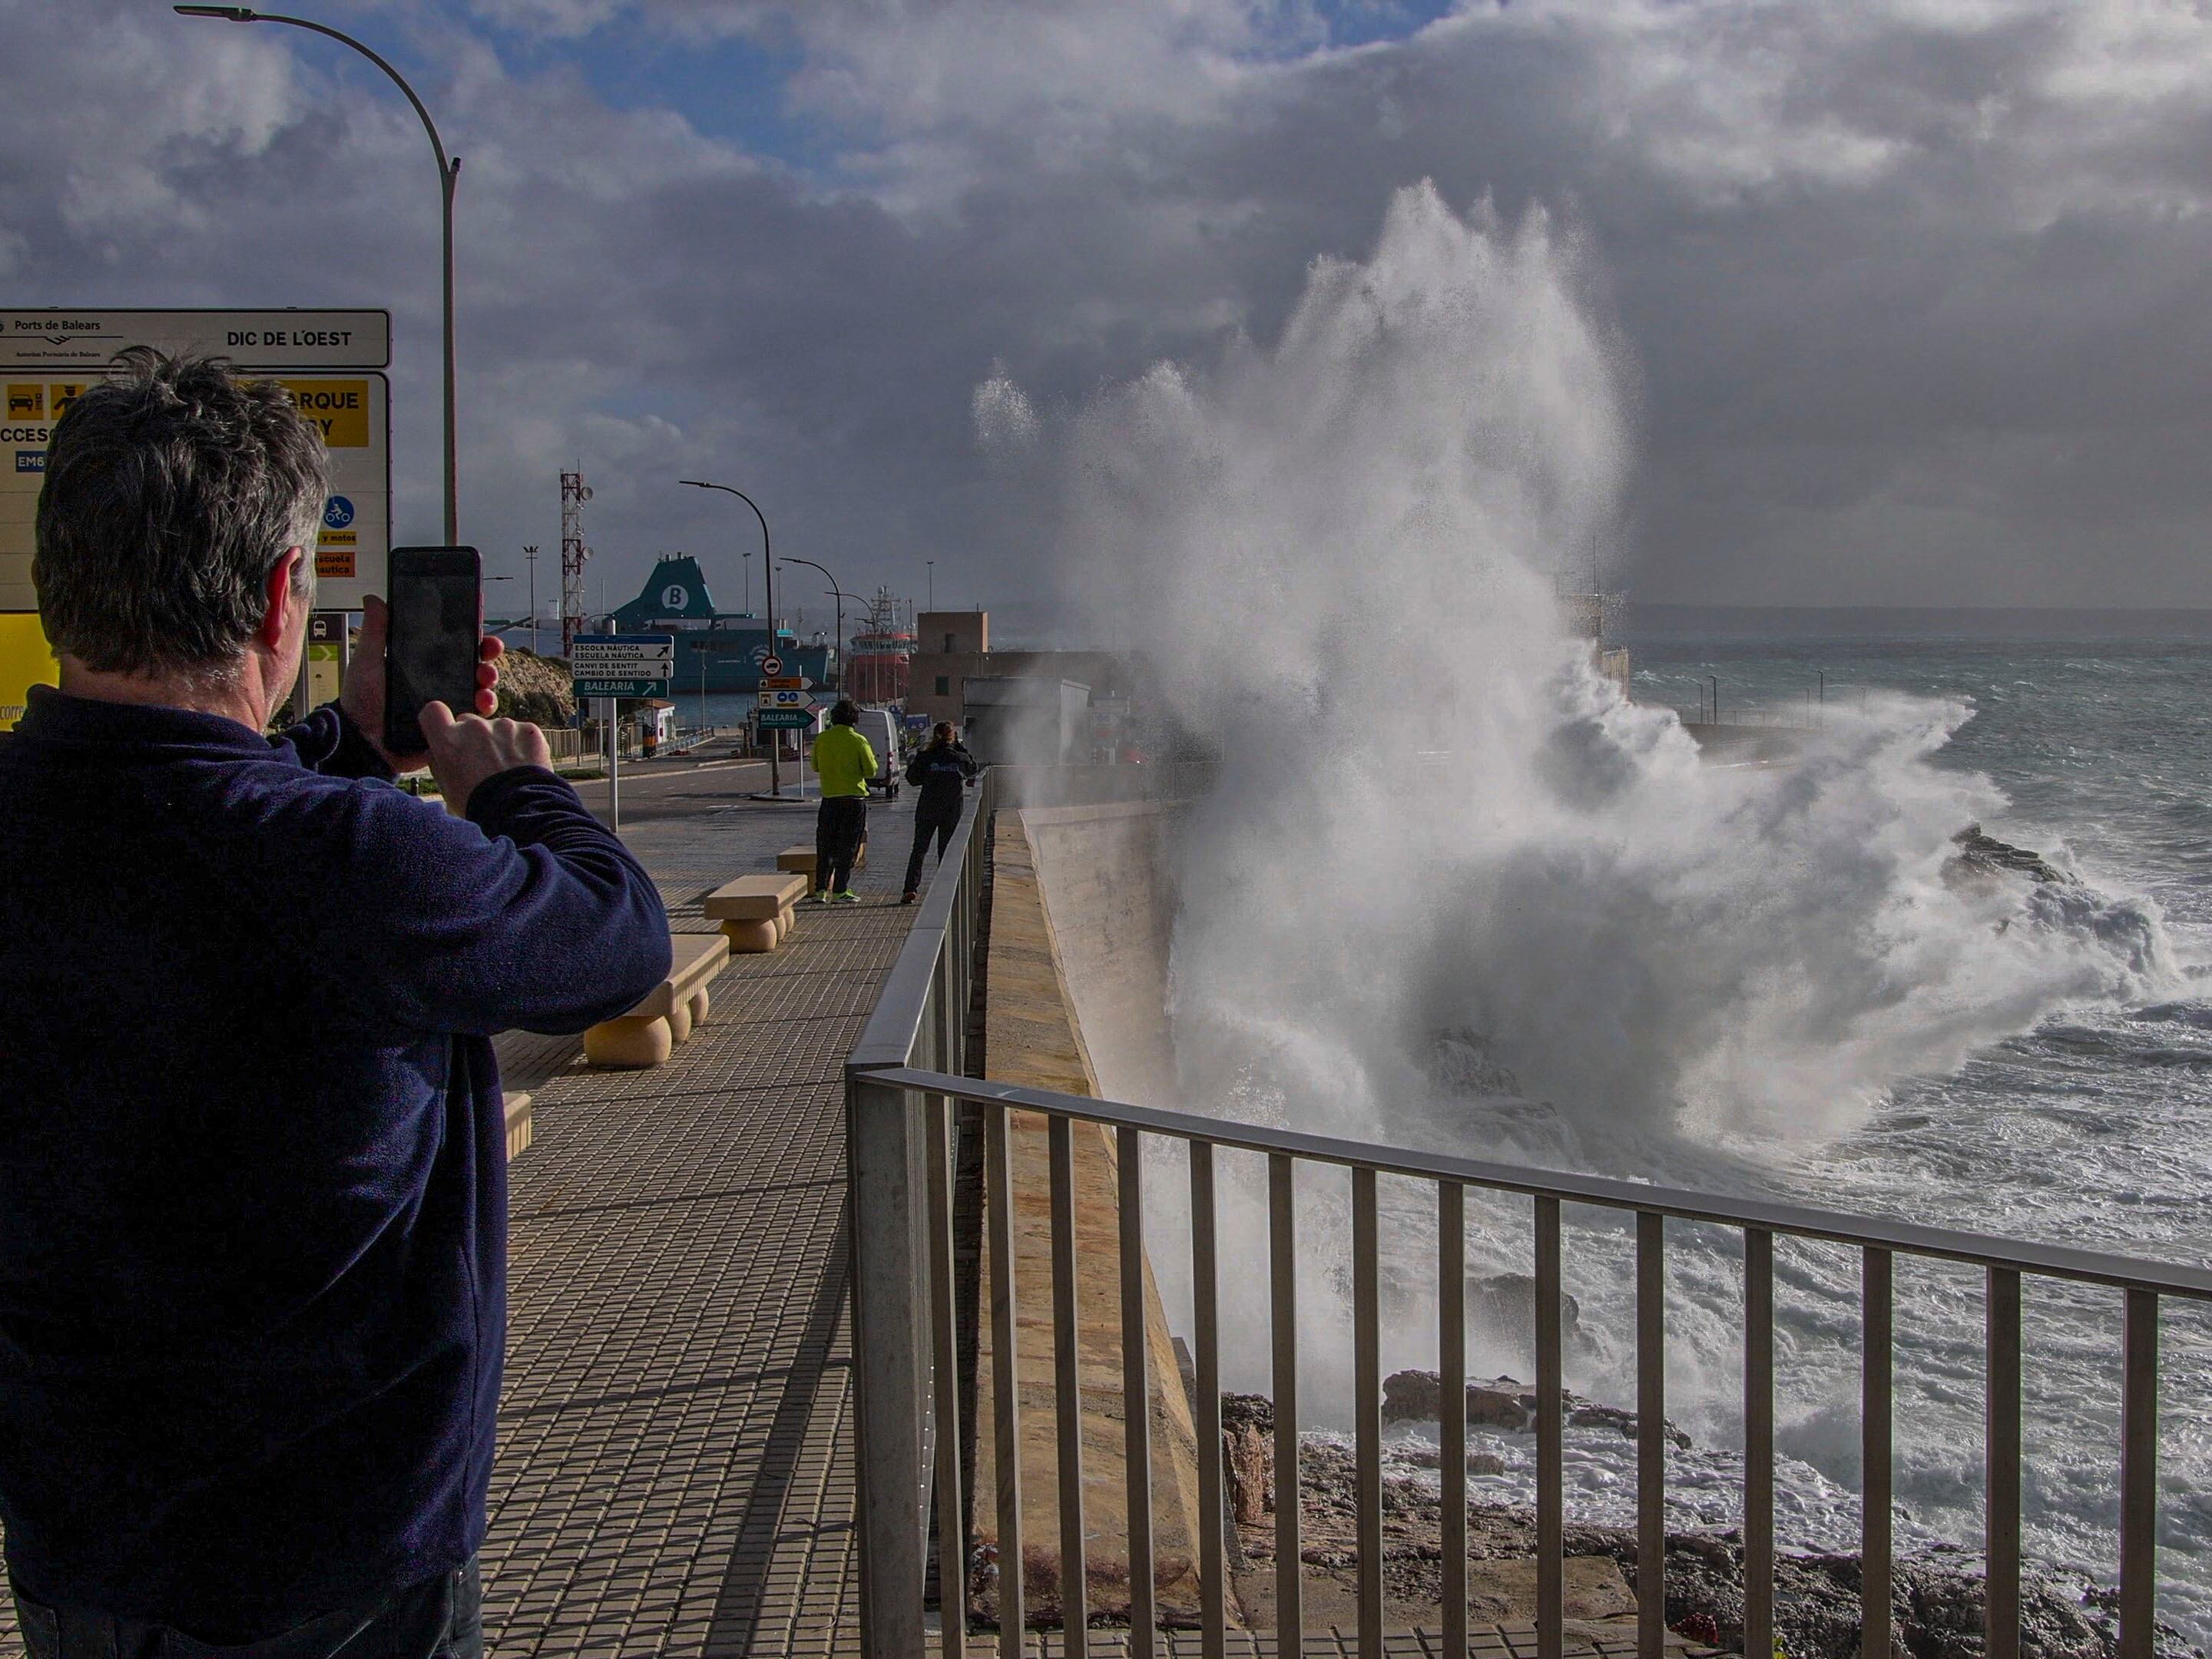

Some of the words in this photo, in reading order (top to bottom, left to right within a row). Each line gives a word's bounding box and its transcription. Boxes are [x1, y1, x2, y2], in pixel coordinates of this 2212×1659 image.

[15, 320, 42, 330] Ports
[45, 320, 58, 330] de
[62, 320, 101, 330] Balears
[227, 331, 257, 346] DIC
[263, 331, 286, 346] DE
[1, 429, 55, 442] CCES
[670, 588, 681, 605] B
